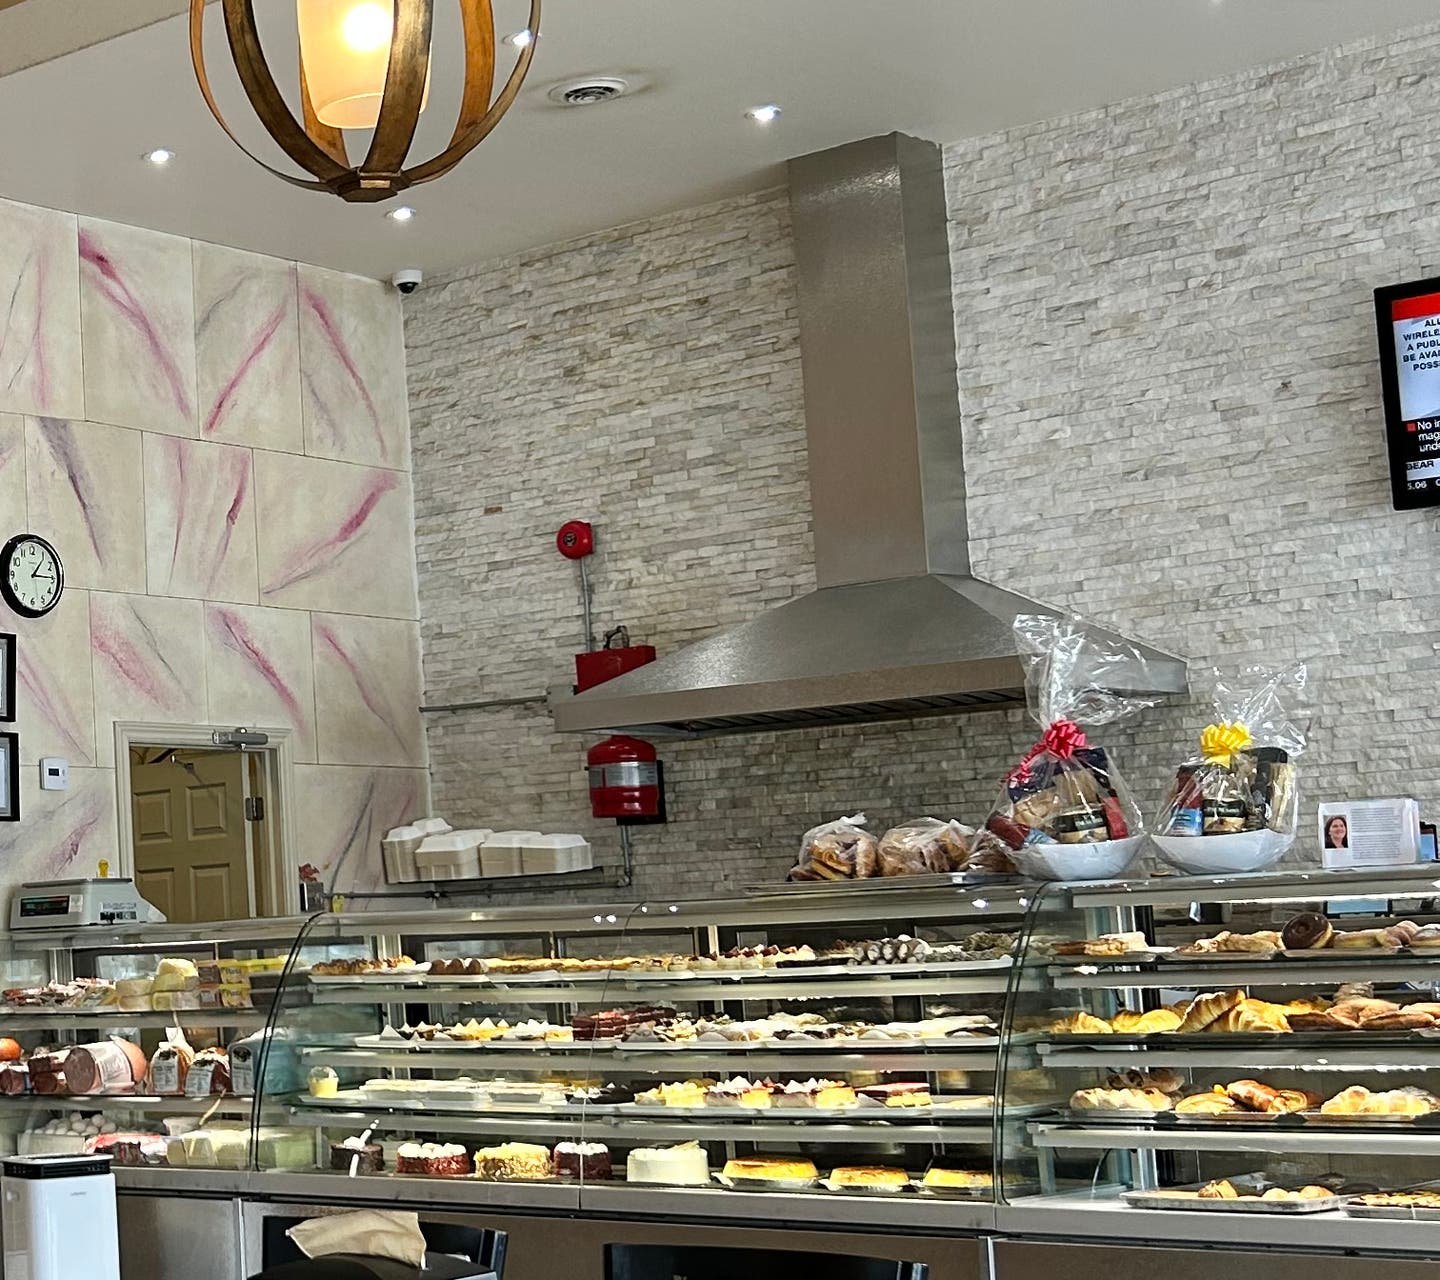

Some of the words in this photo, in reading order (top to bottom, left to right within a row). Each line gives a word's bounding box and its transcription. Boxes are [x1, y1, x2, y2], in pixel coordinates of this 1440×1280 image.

[1407, 343, 1414, 351] A
[1403, 354, 1416, 362] BE
[1417, 421, 1432, 430] No
